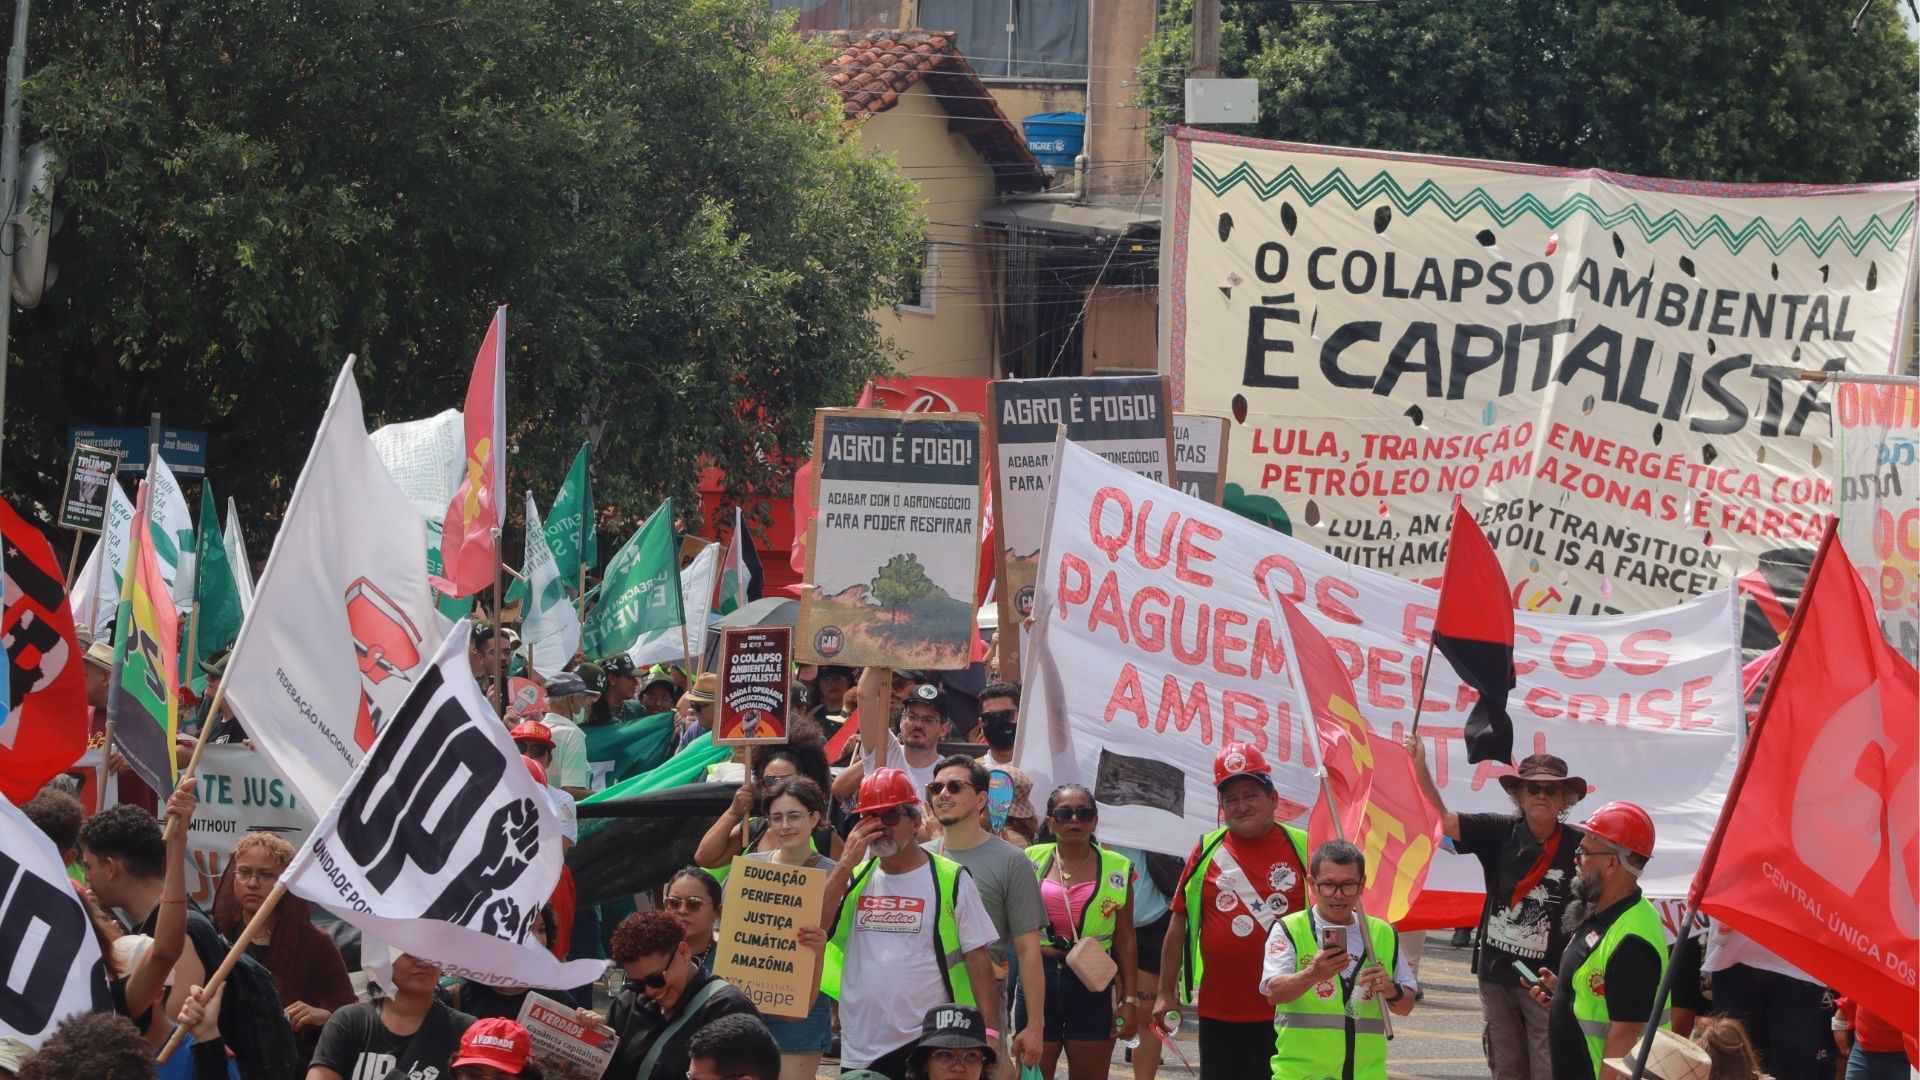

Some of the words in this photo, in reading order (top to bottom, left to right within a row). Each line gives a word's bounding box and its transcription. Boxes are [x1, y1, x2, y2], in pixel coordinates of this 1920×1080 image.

[1028, 141, 1052, 151] TIGRE
[1255, 241, 1289, 283] O
[1307, 246, 1554, 305] COLAPSO
[1566, 256, 1856, 343] AMBIENTAL
[1243, 292, 1300, 390] É
[1319, 318, 1848, 438] CAPITALISTA
[1003, 398, 1063, 425] AGRO
[1070, 393, 1085, 423] É
[1090, 394, 1156, 422] FOGO!
[75, 437, 122, 447] Governador
[163, 438, 175, 450] José
[1174, 426, 1190, 441] UA
[828, 434, 885, 463] AGRO
[892, 433, 905, 464] É
[911, 437, 972, 466] FOGO!
[1008, 454, 1049, 469] ACABAR
[1101, 449, 1160, 464] ONEGÓCIO
[1175, 444, 1206, 464] RAS
[77, 456, 112, 473] TRUMP
[1252, 427, 1350, 463] LULA,
[1361, 421, 1534, 463] TRANSIÇÃO
[1546, 421, 1762, 501] ENERGÉTICA
[1771, 475, 1834, 506] COM
[1009, 475, 1045, 491] PARA
[828, 492, 867, 506] ACABAR
[870, 494, 890, 507] COM
[893, 495, 900, 508] O
[903, 494, 971, 510] AGRONEGÓCIO
[1260, 461, 1431, 498] PETRÓLEO
[1437, 463, 1480, 493] NO
[1692, 490, 1712, 529] É
[826, 512, 860, 530] PARA
[863, 514, 906, 532] PODER
[910, 516, 972, 534] RESPIRAR
[1089, 486, 1223, 588] QUE
[1328, 518, 1401, 542] LULA,
[1408, 513, 1441, 537] AN
[1549, 507, 1722, 570] TRANSITION
[1325, 544, 1394, 569] WITH
[1506, 523, 1547, 556] OIL
[1555, 539, 1581, 566] IS
[1585, 549, 1605, 575] A
[1614, 555, 1718, 596] FARCE!
[1254, 554, 1364, 625] OS
[821, 635, 838, 648] CAB
[1057, 552, 1295, 690] PAGUEM
[1524, 675, 1715, 732] CRISE
[730, 663, 775, 674] AMBIENTAL
[732, 655, 739, 664] O
[740, 653, 783, 663] COLAPSO
[729, 673, 782, 683] CAPITALISTA!
[729, 688, 748, 700] SAÍDA
[276, 667, 318, 725] FEDERAÇÃO
[318, 720, 355, 769] NACIONAL
[337, 663, 507, 896] UP
[188, 819, 237, 834] WITHOUT
[312, 837, 351, 897] UNIDADE
[744, 865, 807, 887] EDUCAÇÃO
[740, 887, 803, 908] PERIFERIA
[864, 897, 919, 909] CSP
[743, 911, 793, 931] JUSTIÇA
[1762, 861, 1825, 923] CENTRAL
[1828, 910, 1882, 963] ÚNICA
[1886, 950, 1917, 987] DOS
[734, 931, 797, 952] CLIMÁTICA
[731, 953, 794, 973] AMAZÔNIA
[743, 981, 795, 1007] Ágape
[752, 981, 797, 992] INSTITUTO
[531, 1006, 541, 1019] A
[541, 1011, 584, 1039] VERDADE
[936, 1010, 954, 1030] UP
[471, 1034, 479, 1044] A
[478, 1036, 515, 1050] VERDADE
[526, 1023, 562, 1046] Ganância
[562, 1040, 603, 1065] capitalista
[352, 1052, 397, 1080] UP
[561, 1047, 596, 1068] natureza
